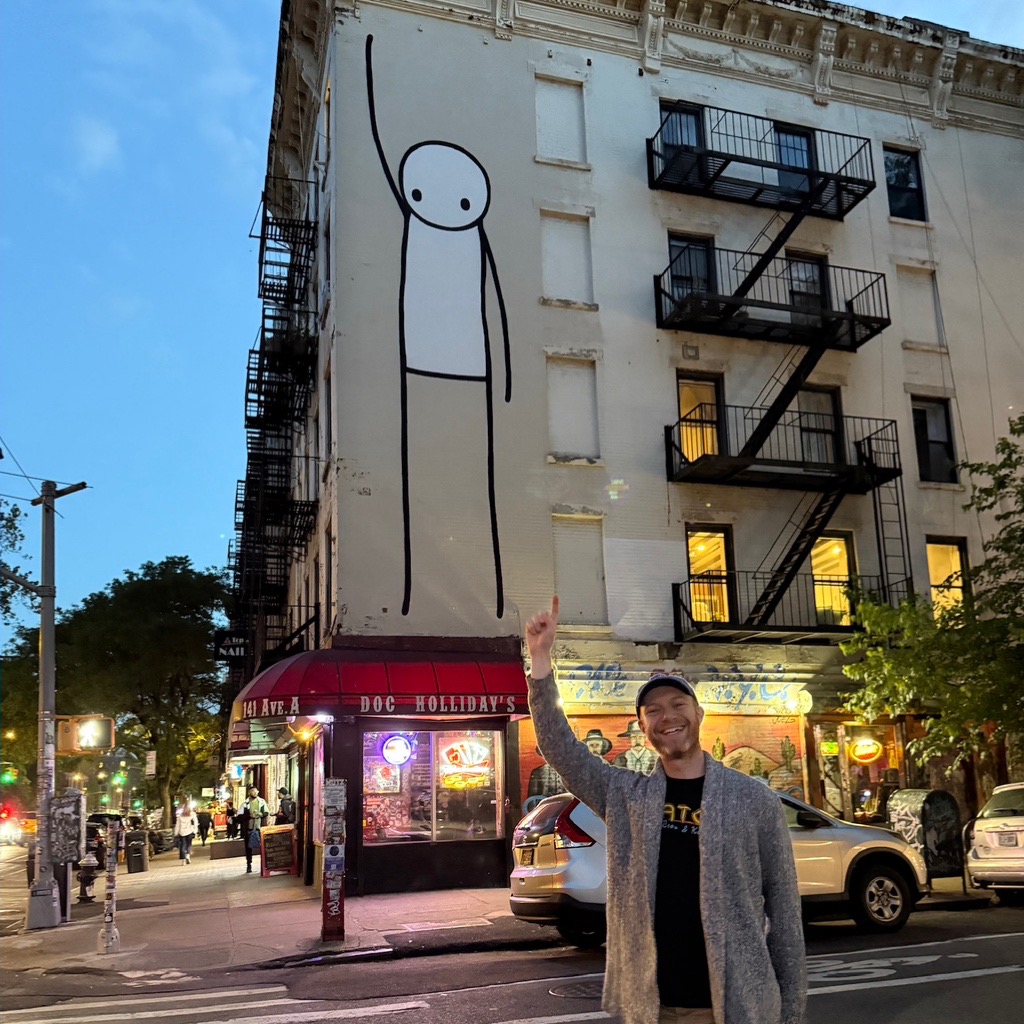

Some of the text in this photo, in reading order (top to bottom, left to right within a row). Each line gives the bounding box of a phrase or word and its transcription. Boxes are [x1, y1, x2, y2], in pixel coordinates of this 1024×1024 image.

[243, 700, 257, 718] 141
[360, 695, 516, 713] DOC HOLLIDAY'S
